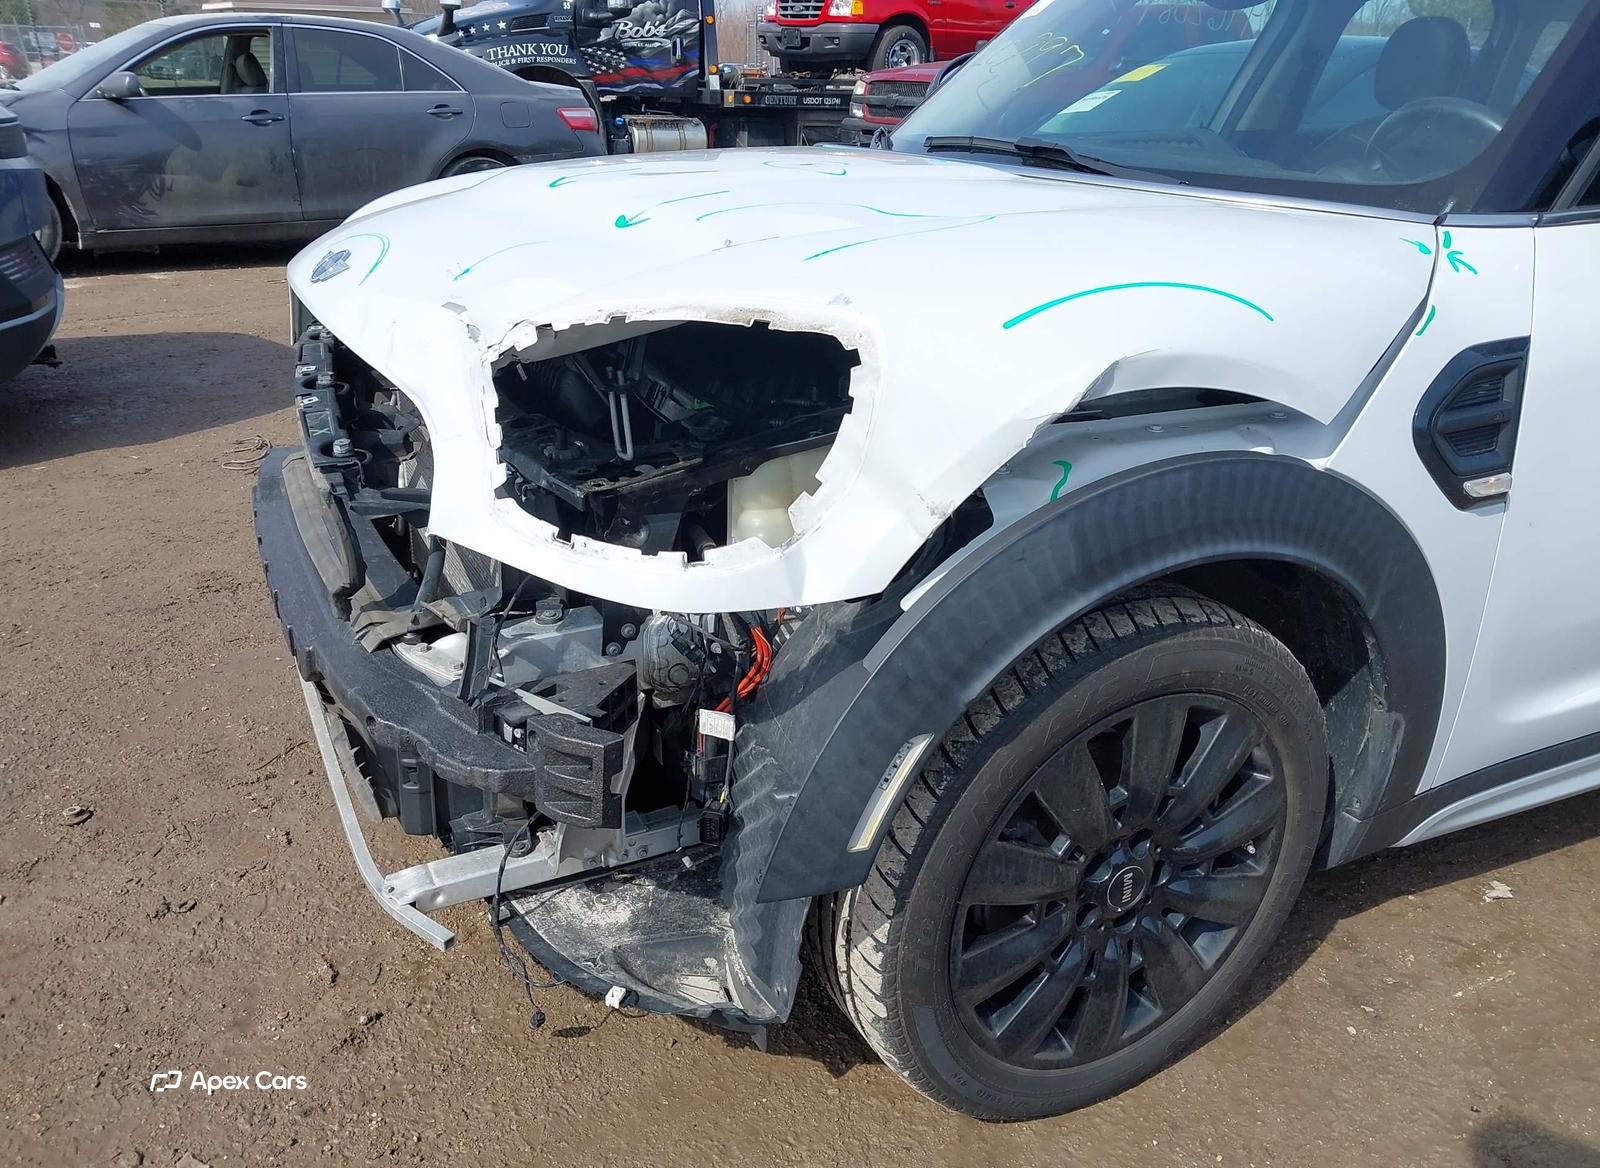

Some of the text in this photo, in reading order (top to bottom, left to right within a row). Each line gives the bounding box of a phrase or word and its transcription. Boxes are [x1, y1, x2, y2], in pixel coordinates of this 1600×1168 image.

[611, 20, 668, 40] Bob's
[487, 43, 569, 60] THANK YOU
[491, 59, 511, 67] LICE
[517, 56, 536, 64] FIRST
[536, 56, 577, 65] RESPONDERS
[765, 95, 797, 105] CENTURY
[802, 97, 823, 105] USDOT
[1121, 872, 1134, 904] MINI
